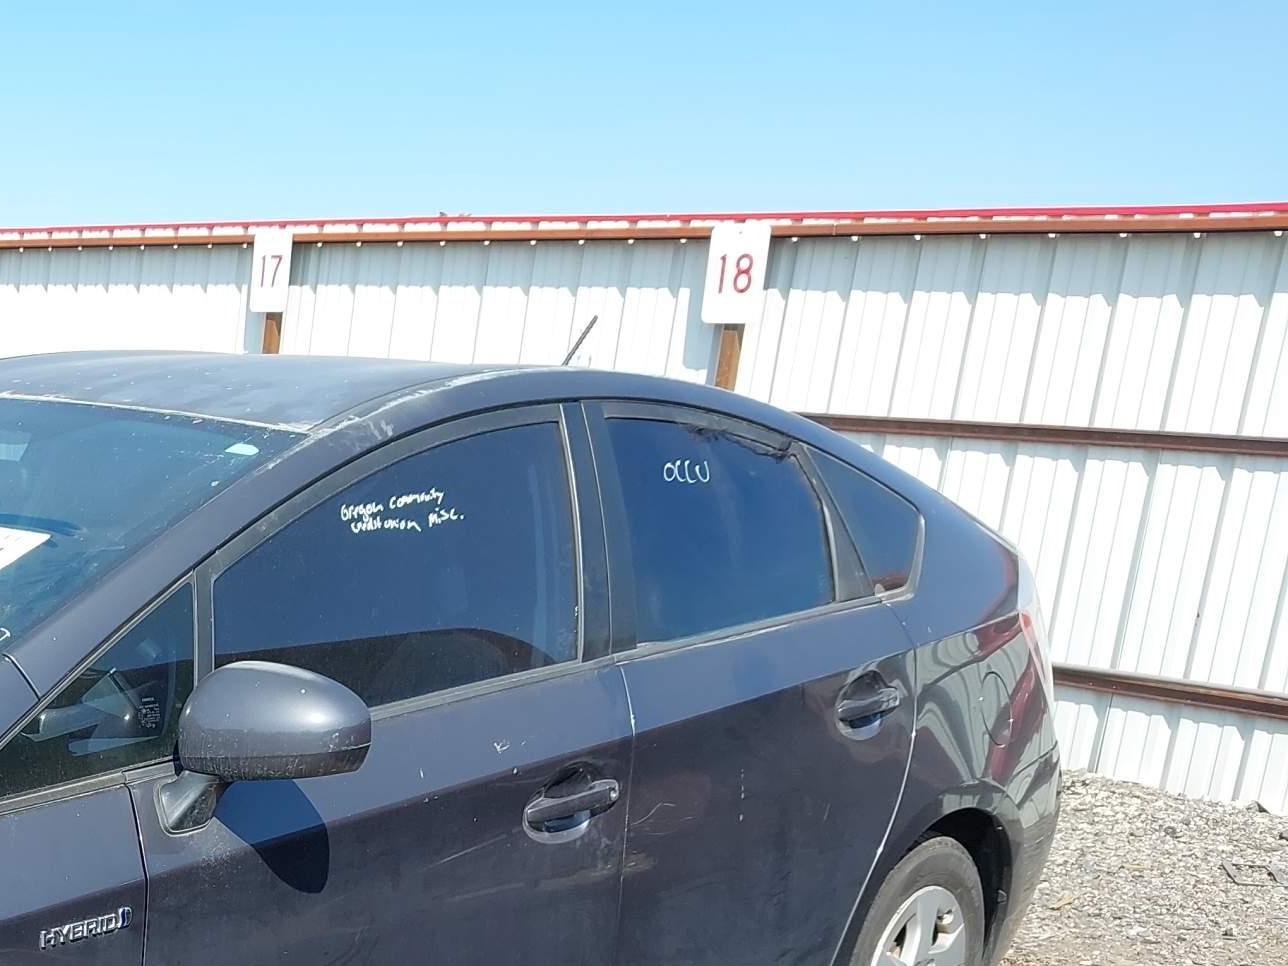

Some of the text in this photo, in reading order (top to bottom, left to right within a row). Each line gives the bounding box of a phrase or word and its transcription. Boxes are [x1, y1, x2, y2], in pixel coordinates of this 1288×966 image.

[260, 254, 283, 288] 17
[718, 253, 754, 294] 18
[39, 912, 118, 950] HYBRID
